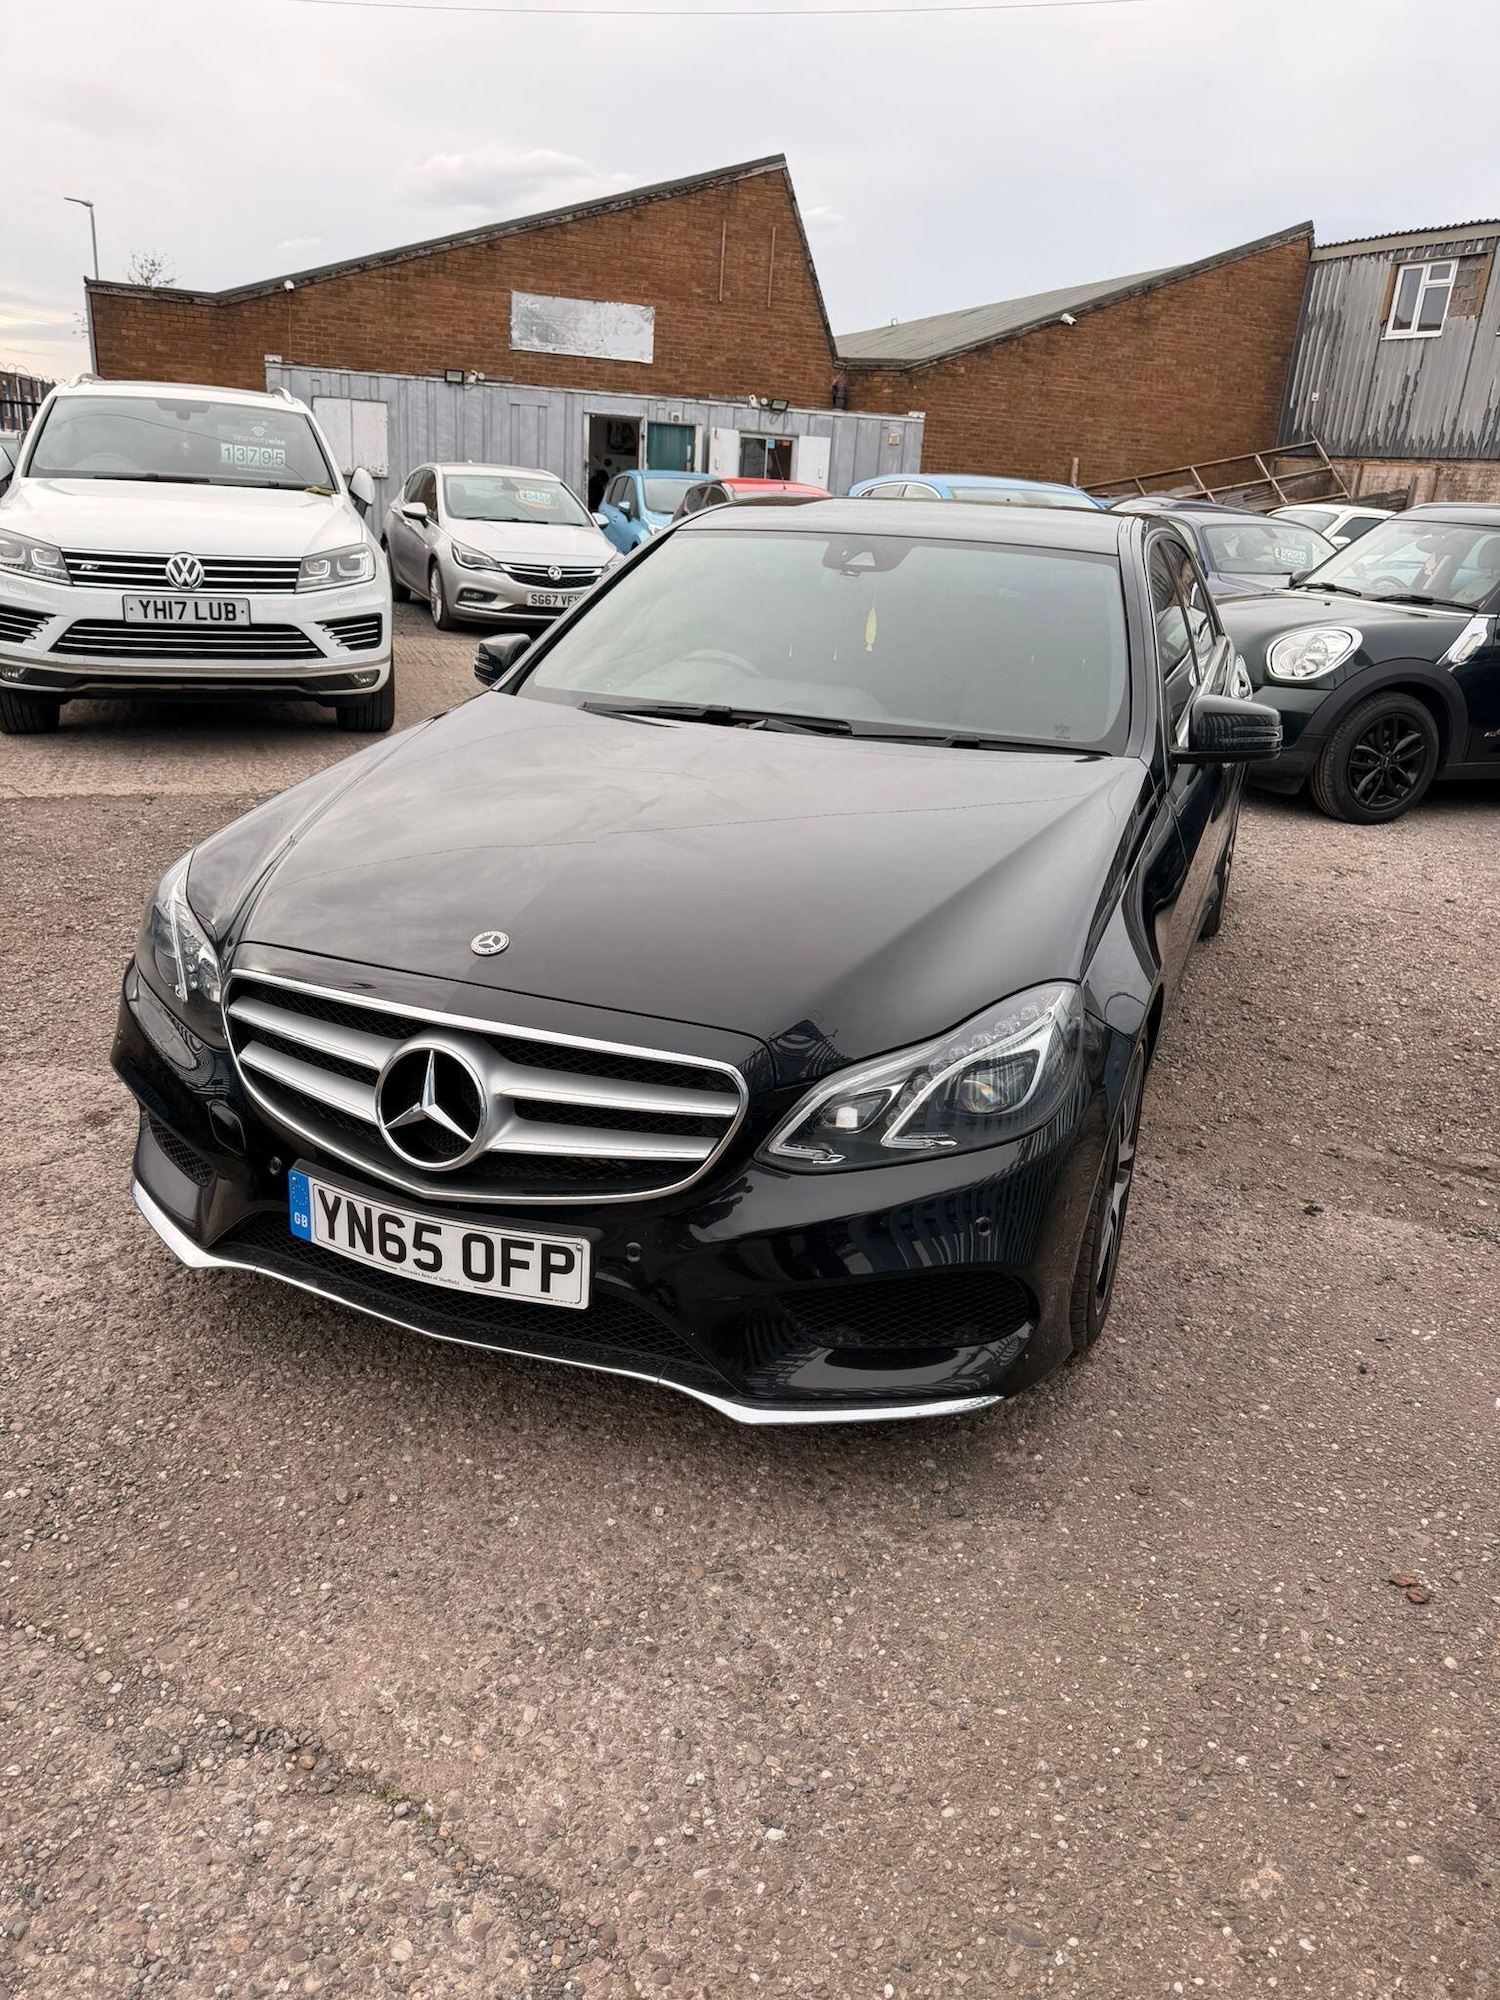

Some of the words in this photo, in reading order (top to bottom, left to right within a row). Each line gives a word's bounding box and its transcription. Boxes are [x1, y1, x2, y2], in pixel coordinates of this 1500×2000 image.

[223, 446, 285, 466] 13795
[531, 594, 558, 605] SG67
[138, 600, 187, 620] YH17
[194, 601, 237, 621] LUB
[294, 1212, 308, 1228] GB
[318, 1189, 443, 1273] YN65
[461, 1233, 575, 1294] OFP
